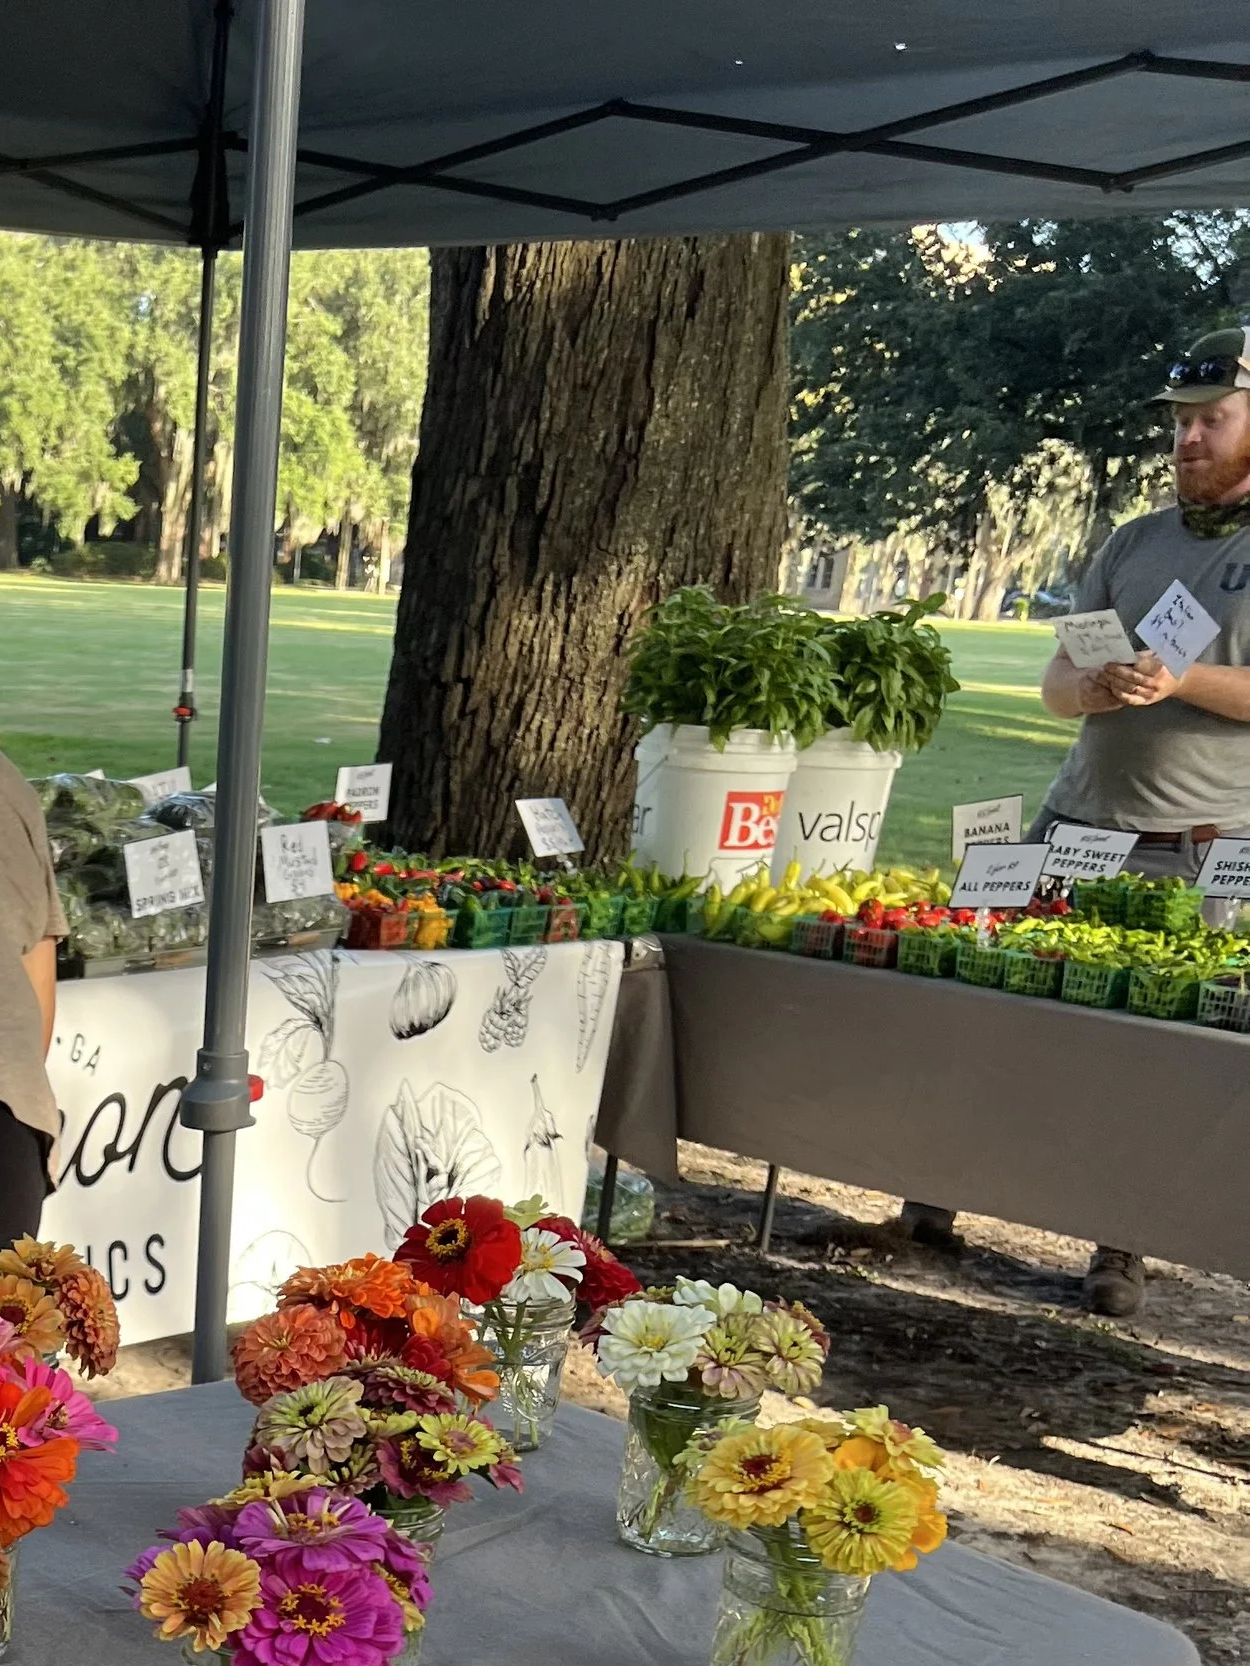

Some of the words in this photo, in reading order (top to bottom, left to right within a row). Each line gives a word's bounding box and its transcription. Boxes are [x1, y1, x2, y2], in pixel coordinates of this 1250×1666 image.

[963, 821, 1011, 836] BANANA
[1082, 848, 1127, 863] SWEET
[1051, 857, 1107, 873] PEPPERS
[958, 881, 978, 893] ALL
[981, 880, 1032, 893] PEPPERS
[69, 1032, 101, 1076] GA
